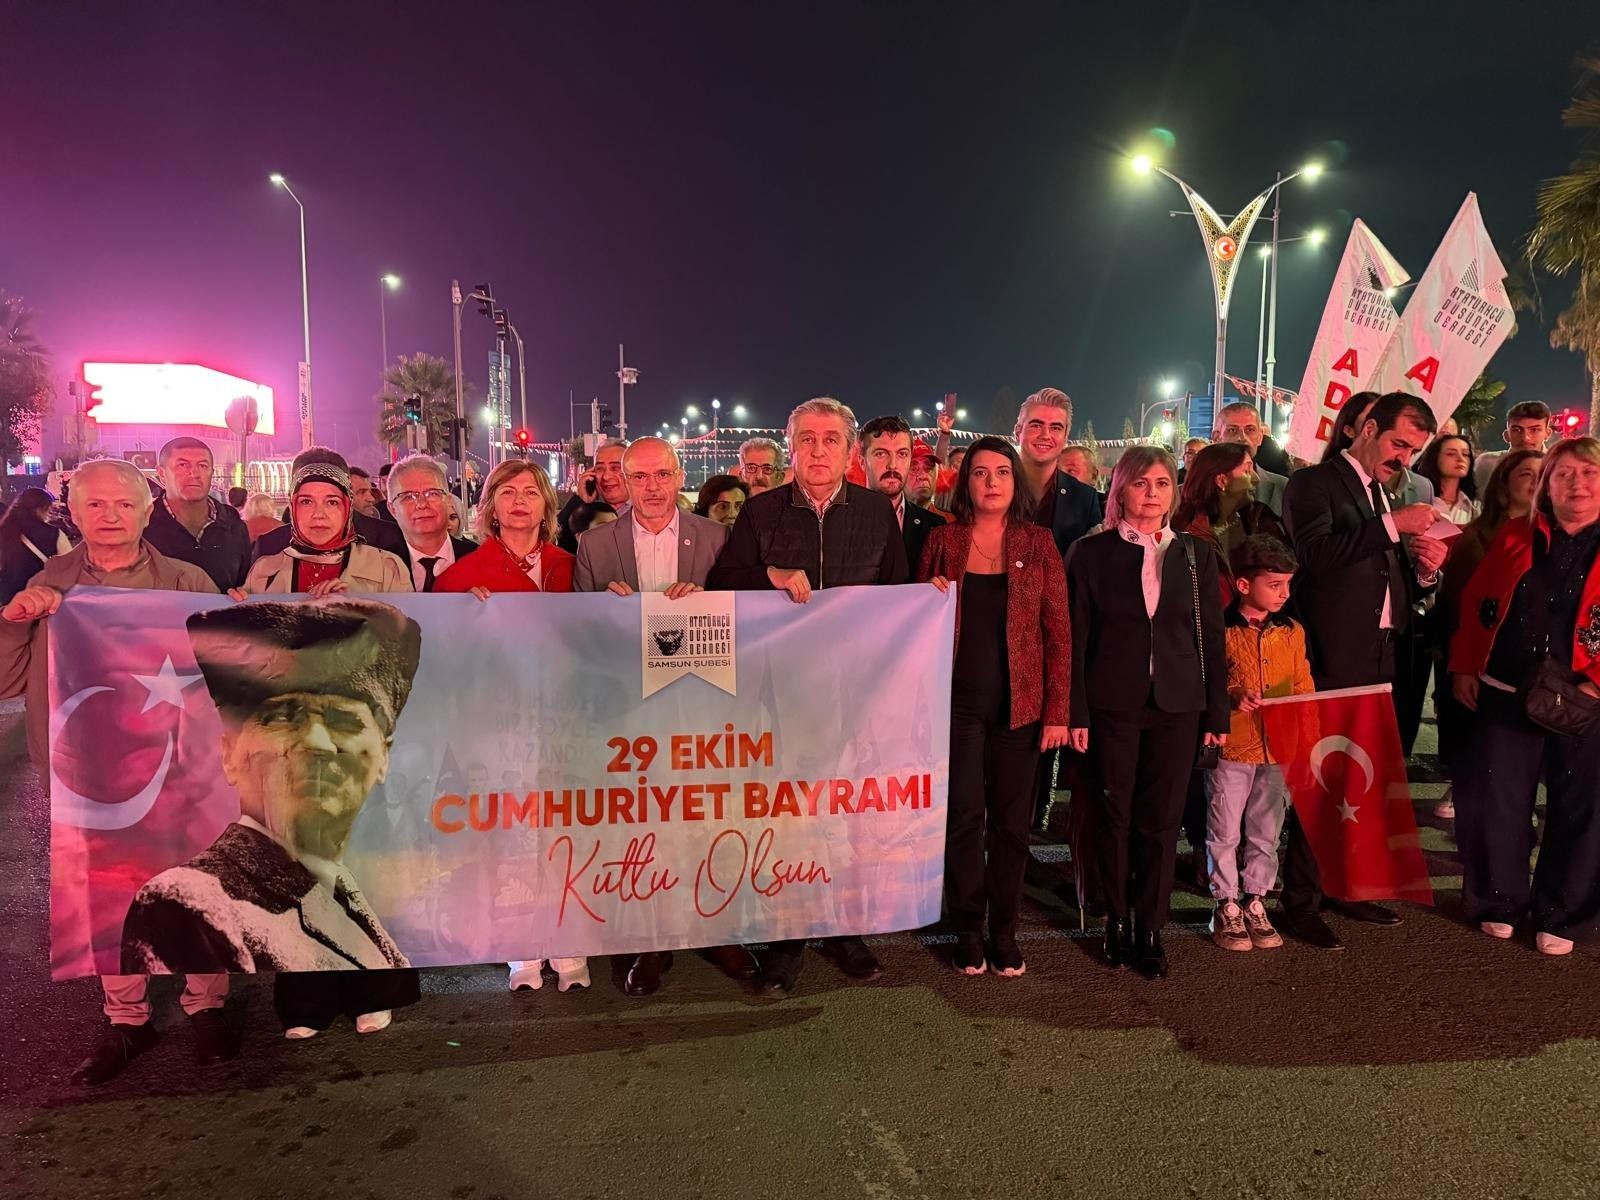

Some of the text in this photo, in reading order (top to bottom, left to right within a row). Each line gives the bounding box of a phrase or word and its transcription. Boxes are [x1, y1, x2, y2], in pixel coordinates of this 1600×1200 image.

[1449, 286, 1506, 324] ATATÜRKÇÜ
[689, 613, 731, 628] ATATÜRKÇÜ
[689, 628, 731, 642] DÜŞÜNCE
[689, 641, 731, 656] DERNEĞİ
[647, 658, 731, 669] SAMSUN ŞUBESİ
[606, 723, 774, 773] 29 EKİM
[431, 773, 931, 834] CUMHURİYET BAYRAMI
[549, 827, 832, 928] Kutlu Olsun
